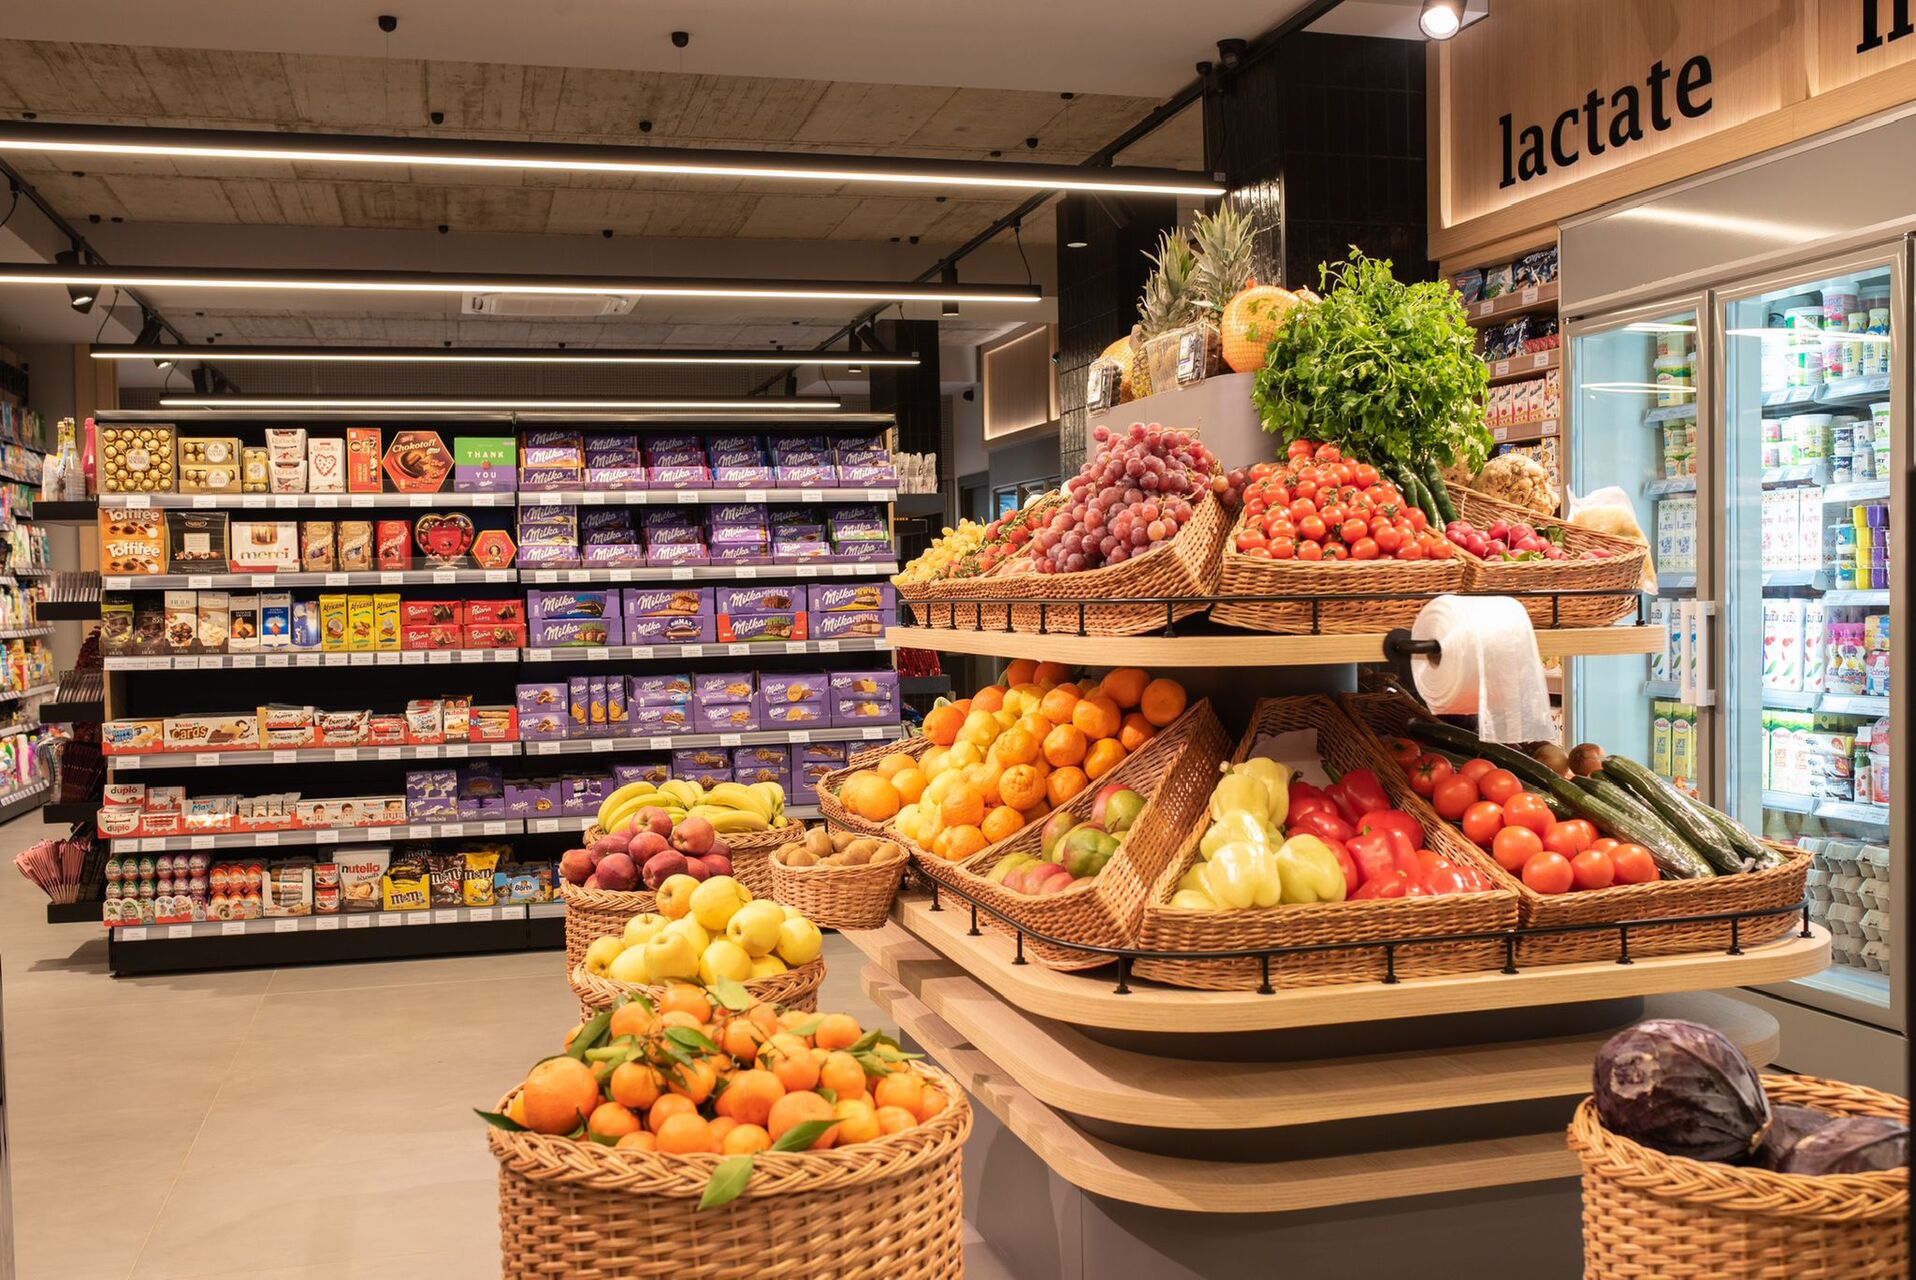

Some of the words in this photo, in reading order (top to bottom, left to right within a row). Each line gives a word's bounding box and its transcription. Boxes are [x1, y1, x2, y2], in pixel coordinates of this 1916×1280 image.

[1498, 54, 1713, 189] lactate
[533, 432, 564, 444] Milka
[589, 437, 621, 450] Milka
[714, 437, 745, 450] Milka
[777, 438, 806, 450] Milka
[837, 438, 865, 450] Milka
[392, 439, 437, 452] Chokotoff
[652, 438, 683, 452] Milka
[532, 450, 564, 463] Milka
[592, 453, 623, 467] Milka
[658, 454, 689, 467] Milka
[718, 453, 749, 467] Milka
[785, 453, 814, 465] Milka
[845, 452, 874, 464] Milka
[530, 469, 563, 482] Milka
[595, 469, 628, 482] Milka
[658, 468, 690, 481] Milka
[725, 468, 756, 480] Milka
[788, 467, 817, 480] Milka
[848, 467, 878, 479] Milka
[106, 508, 160, 522] Toffifee
[526, 505, 559, 520] Milka
[721, 504, 756, 520] Milka
[585, 511, 616, 527] Milka
[526, 525, 559, 540] Milka
[590, 529, 621, 544] Milka
[654, 528, 686, 544] Milka
[721, 526, 749, 538] Milka
[841, 524, 872, 536] Milka
[106, 542, 160, 558] Toffifee
[240, 548, 289, 559] merci
[527, 546, 560, 560] Milka
[592, 546, 625, 559] Milka
[657, 545, 690, 559] Milka
[722, 548, 749, 558] Milka
[844, 544, 875, 555] Milka
[638, 592, 672, 610] Milka
[730, 589, 763, 607] Milka
[822, 587, 856, 605] Milka
[542, 595, 576, 612] Milka
[637, 621, 661, 635] Milka
[732, 616, 766, 635] Milka
[821, 614, 854, 632] Milka
[544, 623, 580, 640] Milka
[111, 786, 137, 795] duplo
[107, 824, 129, 833] duplo
[342, 863, 380, 873] nutella
